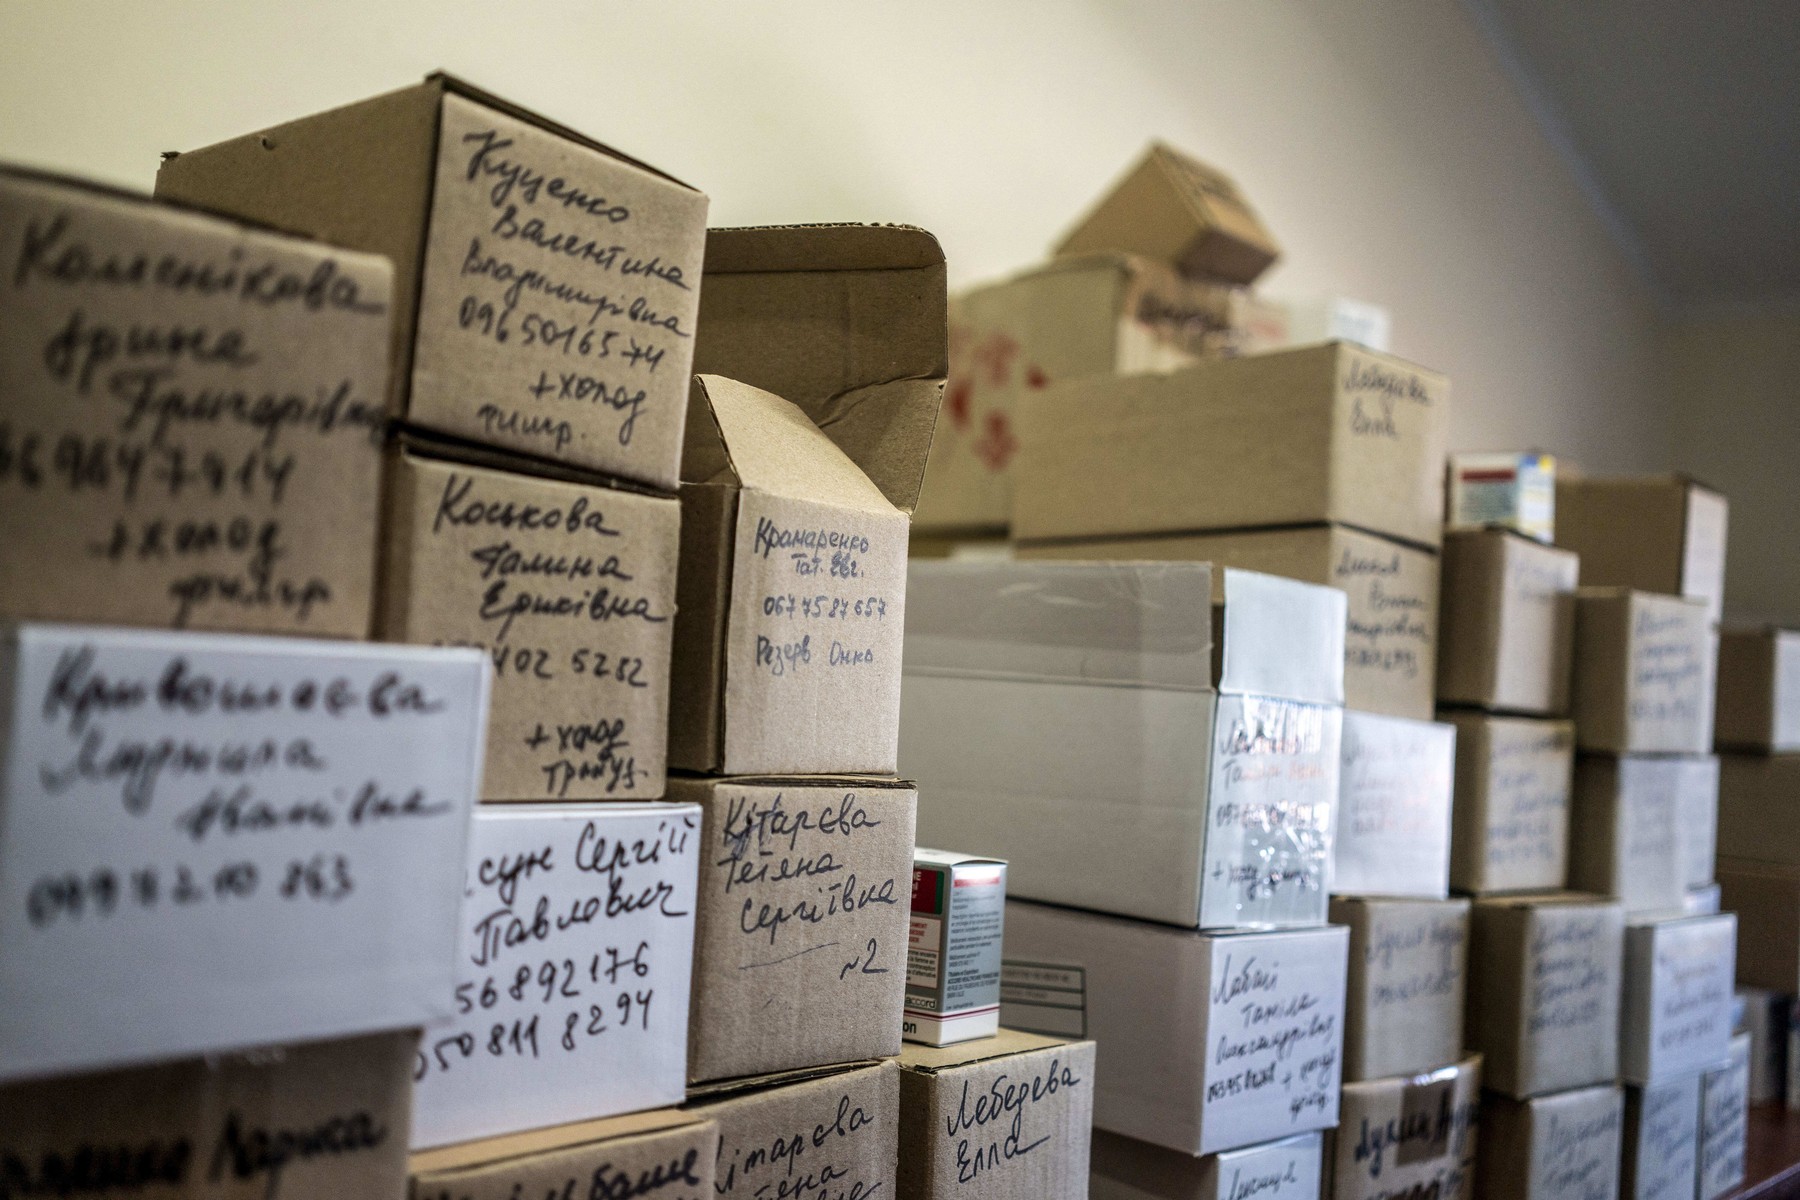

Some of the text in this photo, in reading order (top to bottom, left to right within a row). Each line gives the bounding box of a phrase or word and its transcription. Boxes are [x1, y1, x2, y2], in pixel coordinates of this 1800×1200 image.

[463, 130, 629, 222] Куценко
[492, 204, 691, 290] Валентина
[433, 473, 619, 535] Коськова
[471, 541, 633, 580] Галина
[754, 517, 869, 559] Крамаренко
[575, 817, 696, 884] Сергій
[471, 876, 688, 967] Павлович
[741, 874, 898, 945] Сергіївна
[902, 1021, 917, 1034] on
[905, 996, 936, 1009] accord
[947, 1058, 1080, 1141] Лебедева
[957, 1134, 1051, 1185] Елла
